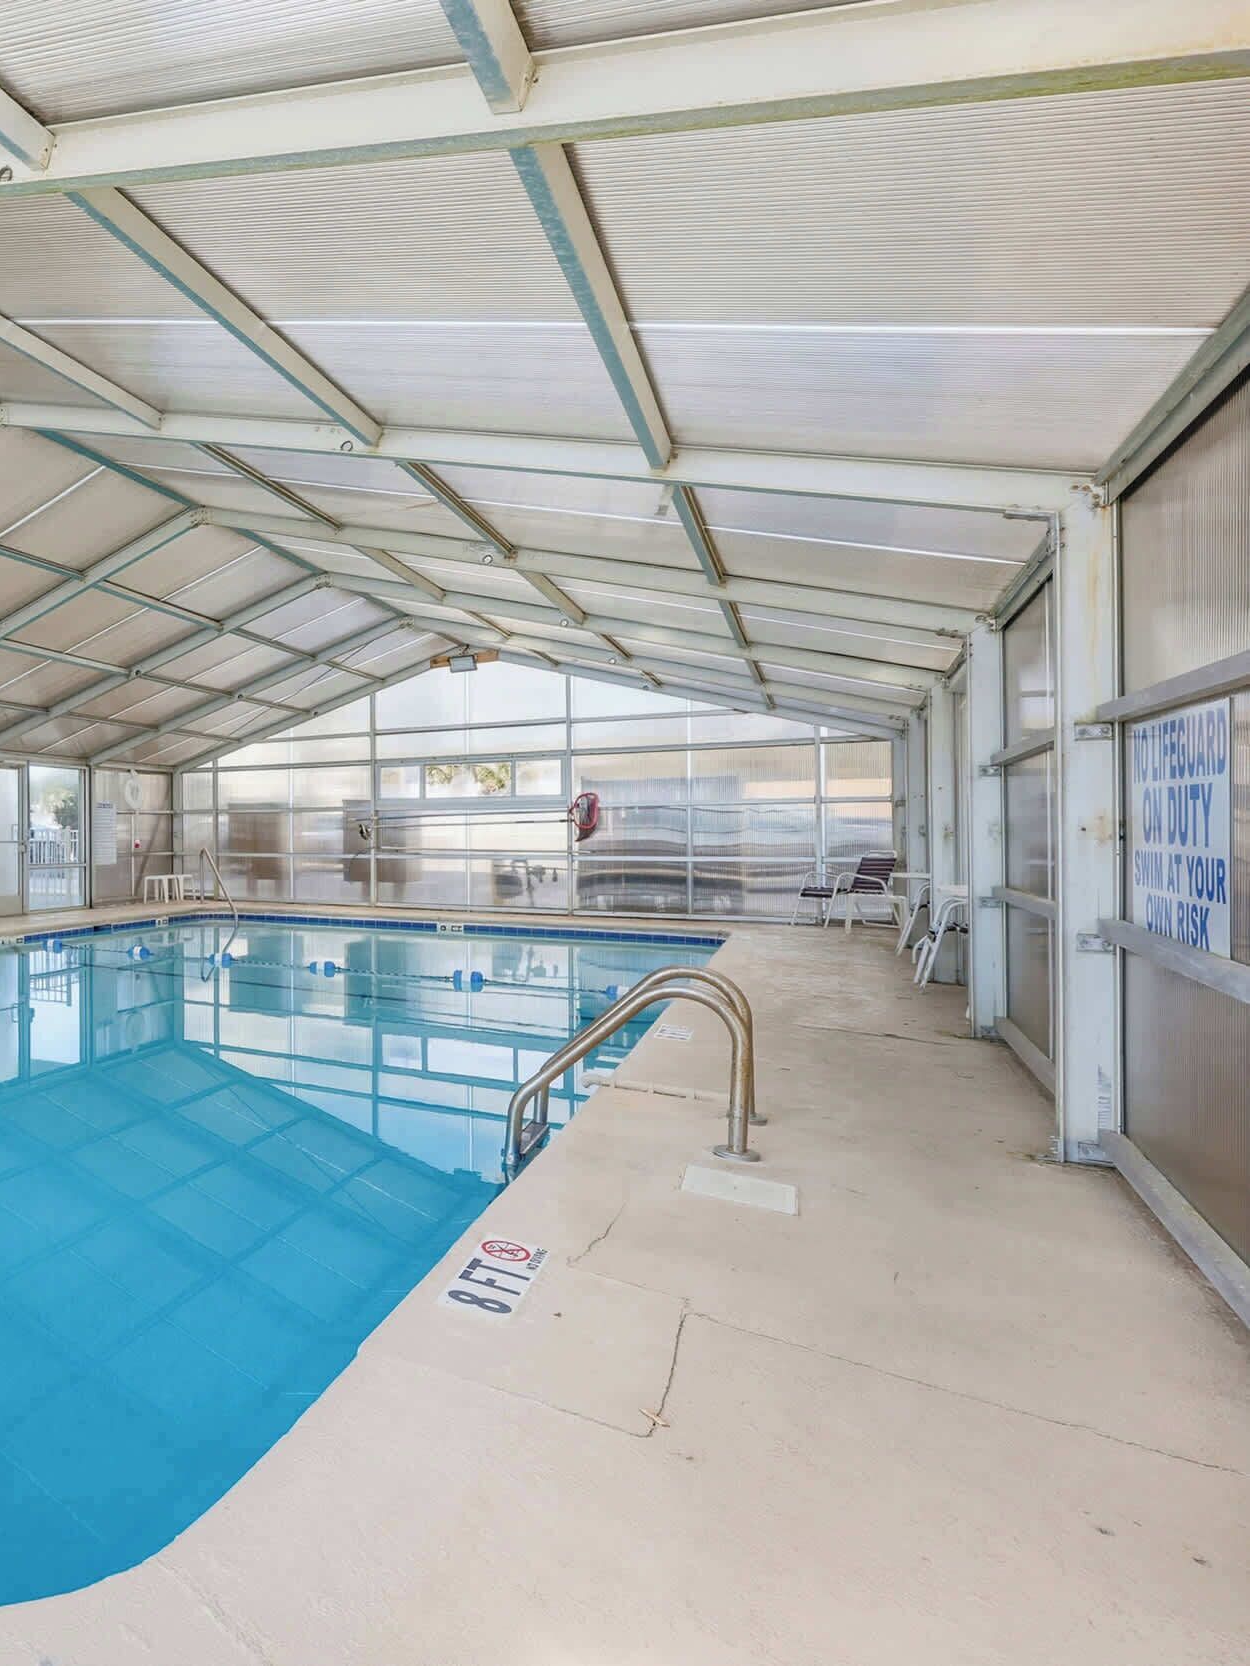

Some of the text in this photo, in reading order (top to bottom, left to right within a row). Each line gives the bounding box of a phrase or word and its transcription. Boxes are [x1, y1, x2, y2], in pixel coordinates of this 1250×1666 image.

[1134, 708, 1226, 784] NO LIFEGUARD
[1143, 783, 1213, 848] ON DUTY
[1135, 850, 1226, 905] SWIM AT YOUR
[1146, 893, 1210, 952] OWN RISK
[448, 1257, 530, 1314] 8 FT
